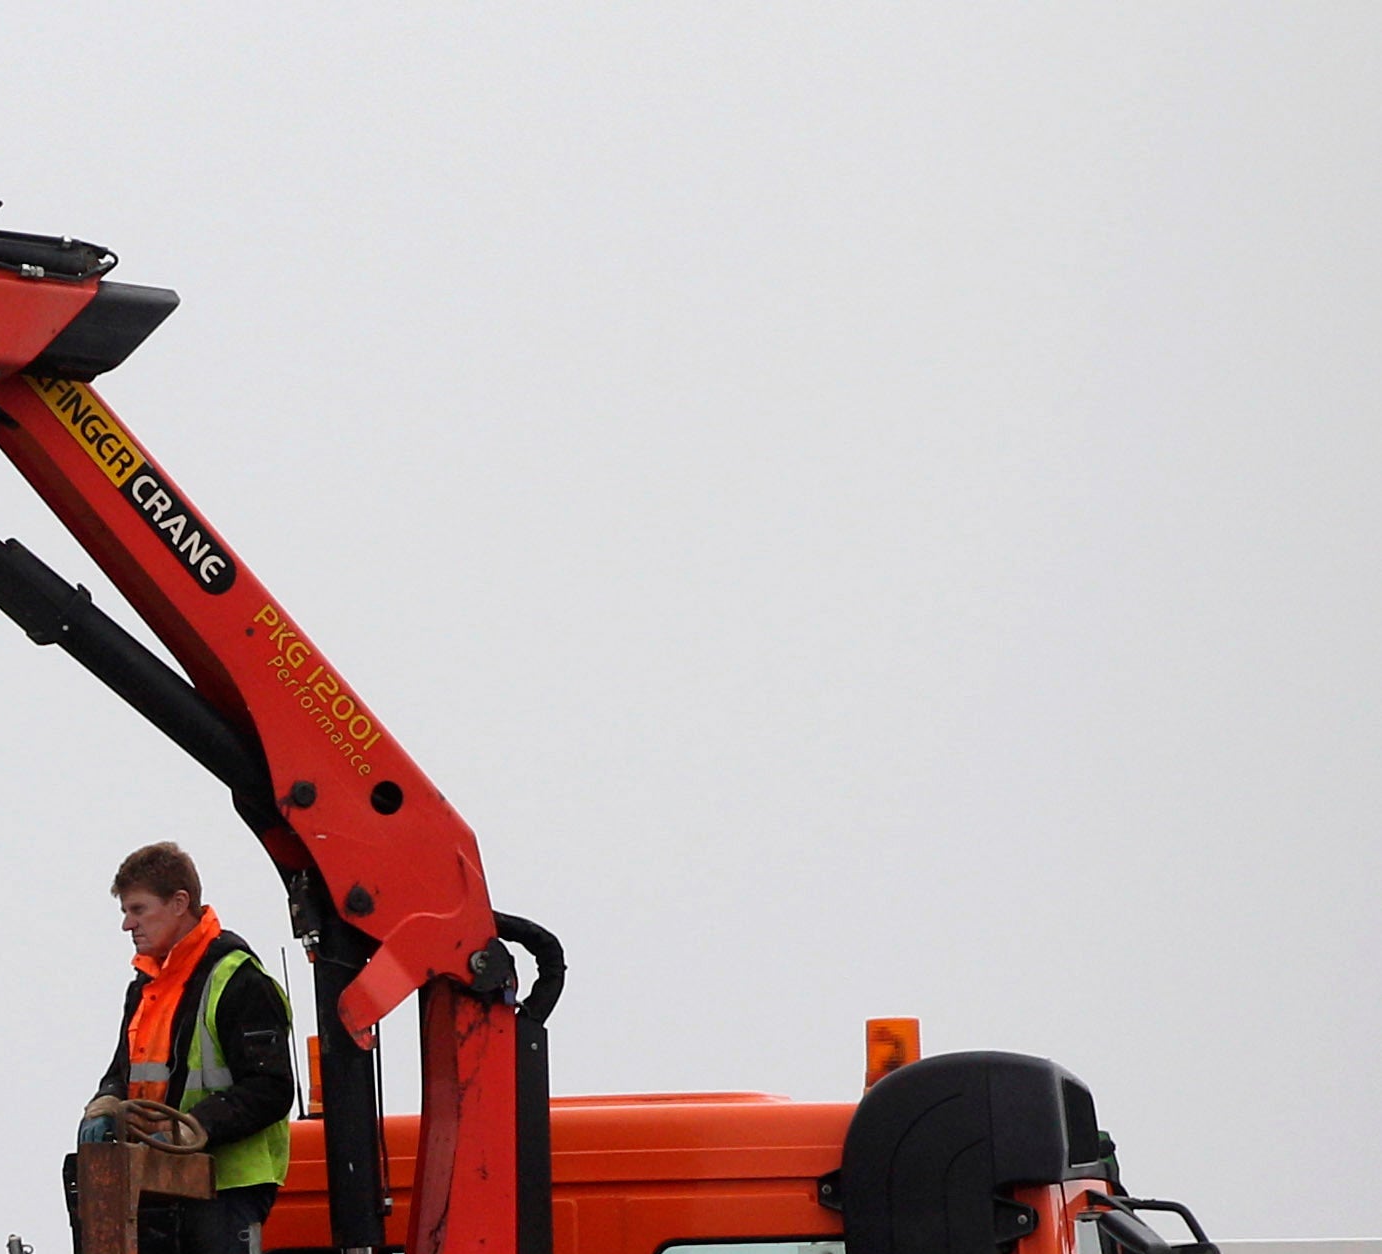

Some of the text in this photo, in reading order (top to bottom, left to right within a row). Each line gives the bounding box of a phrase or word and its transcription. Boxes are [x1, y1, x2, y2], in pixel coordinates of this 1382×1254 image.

[39, 375, 226, 584] FINGER CRANE
[252, 603, 382, 751] PKG 12001
[267, 655, 371, 776] Performance
